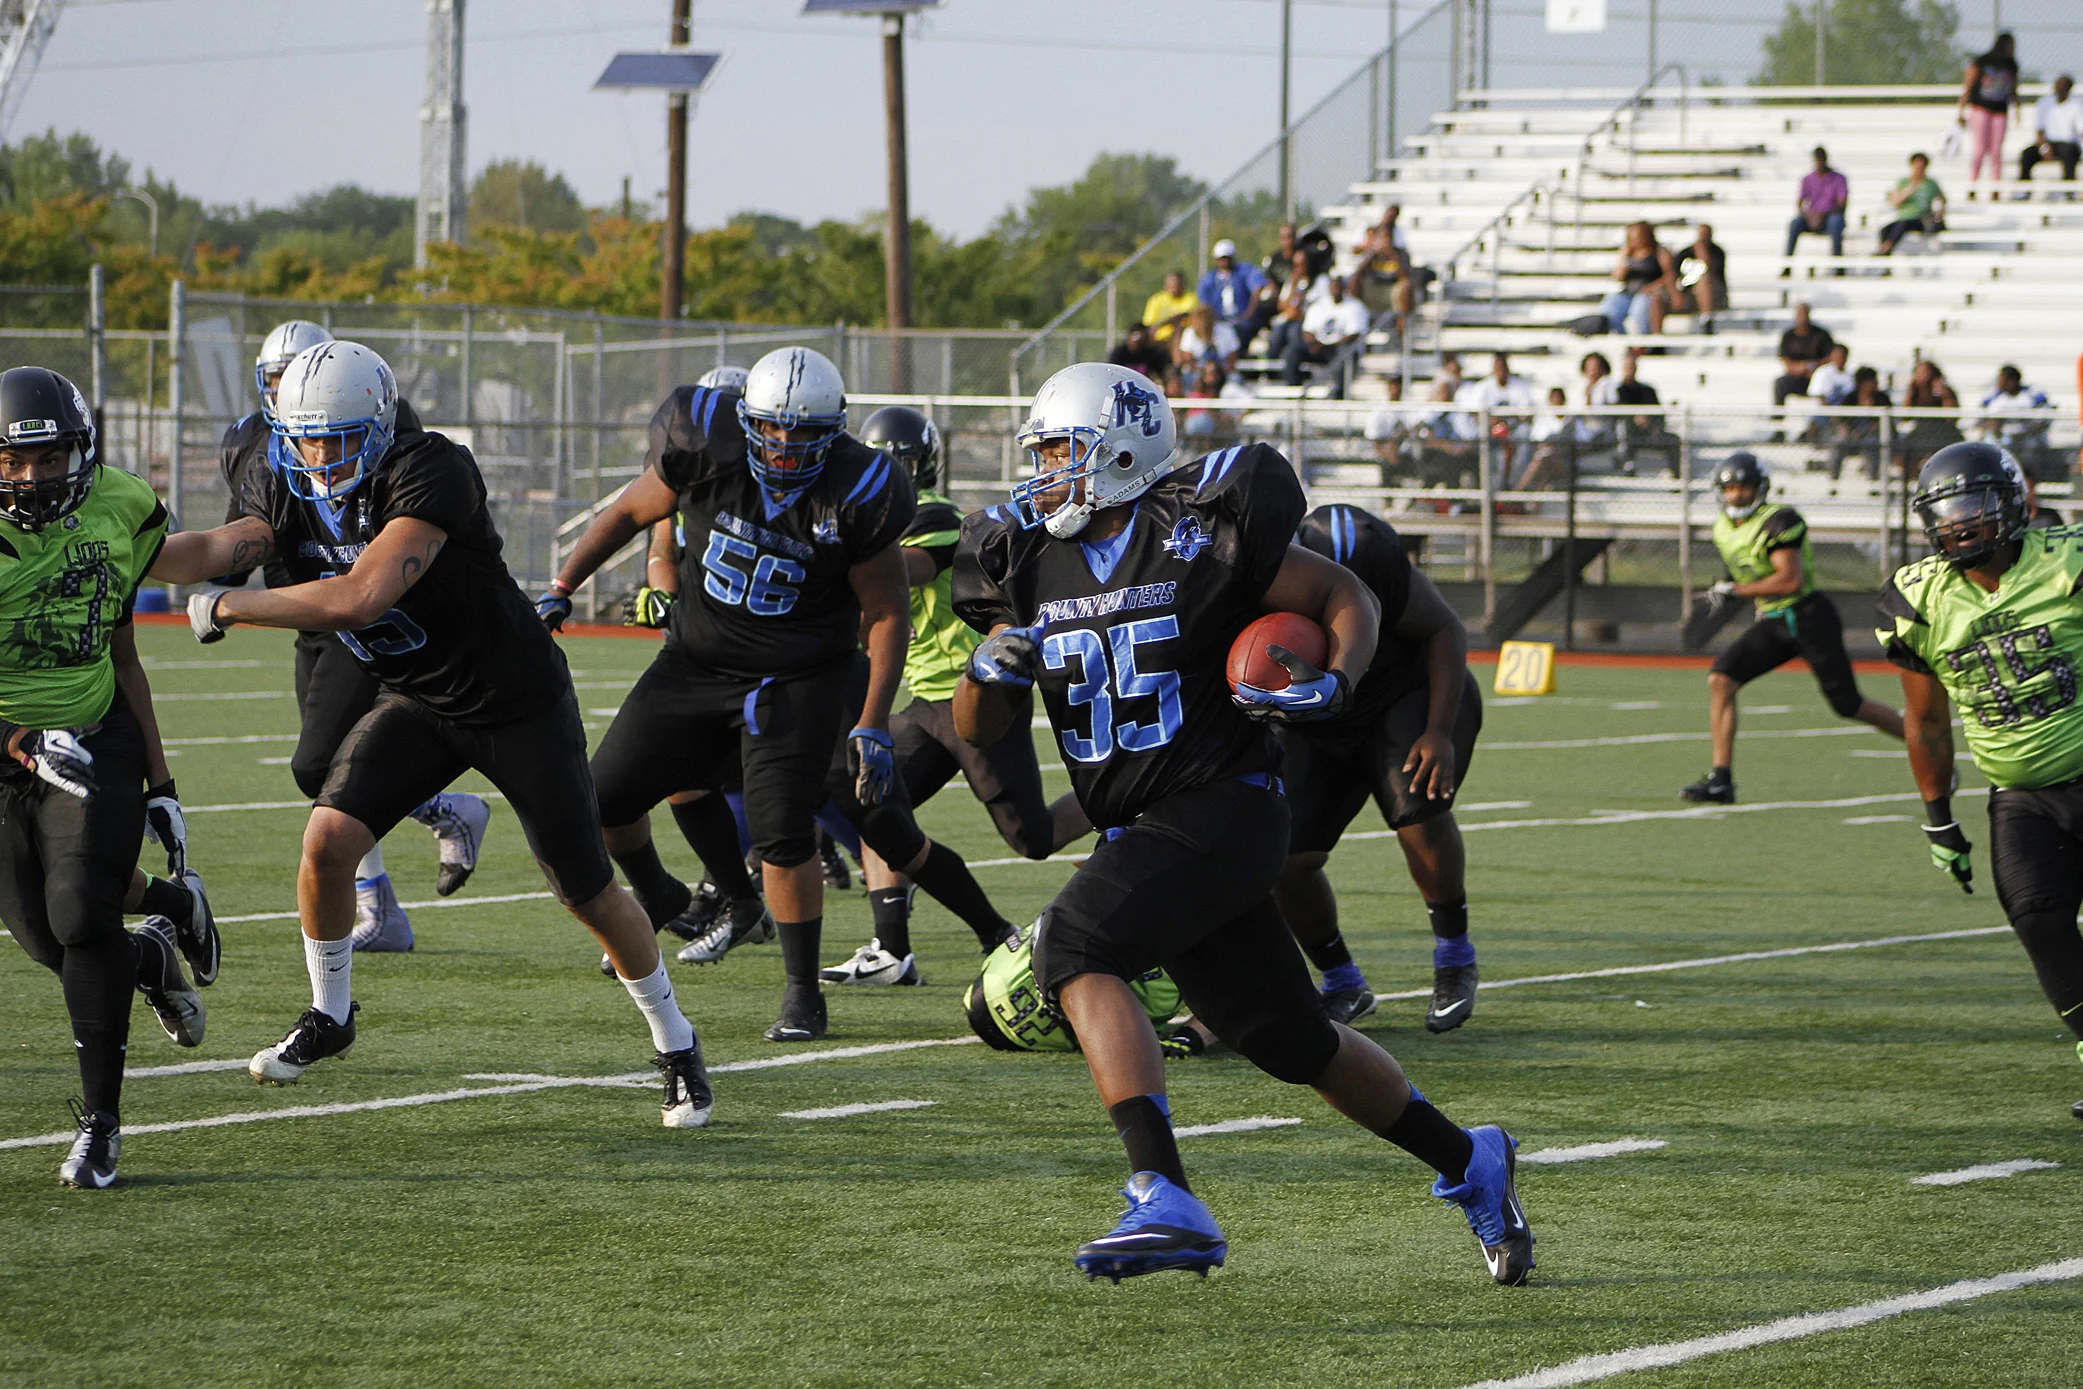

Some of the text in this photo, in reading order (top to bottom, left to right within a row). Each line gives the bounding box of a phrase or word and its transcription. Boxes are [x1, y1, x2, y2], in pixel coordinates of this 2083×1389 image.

[1113, 480, 1141, 501] ADAMS
[702, 529, 806, 616] 56
[1098, 581, 1177, 617] HUNTERS
[1042, 614, 1183, 762] 35
[1504, 648, 1542, 689] 20
[1947, 624, 2076, 727] 35
